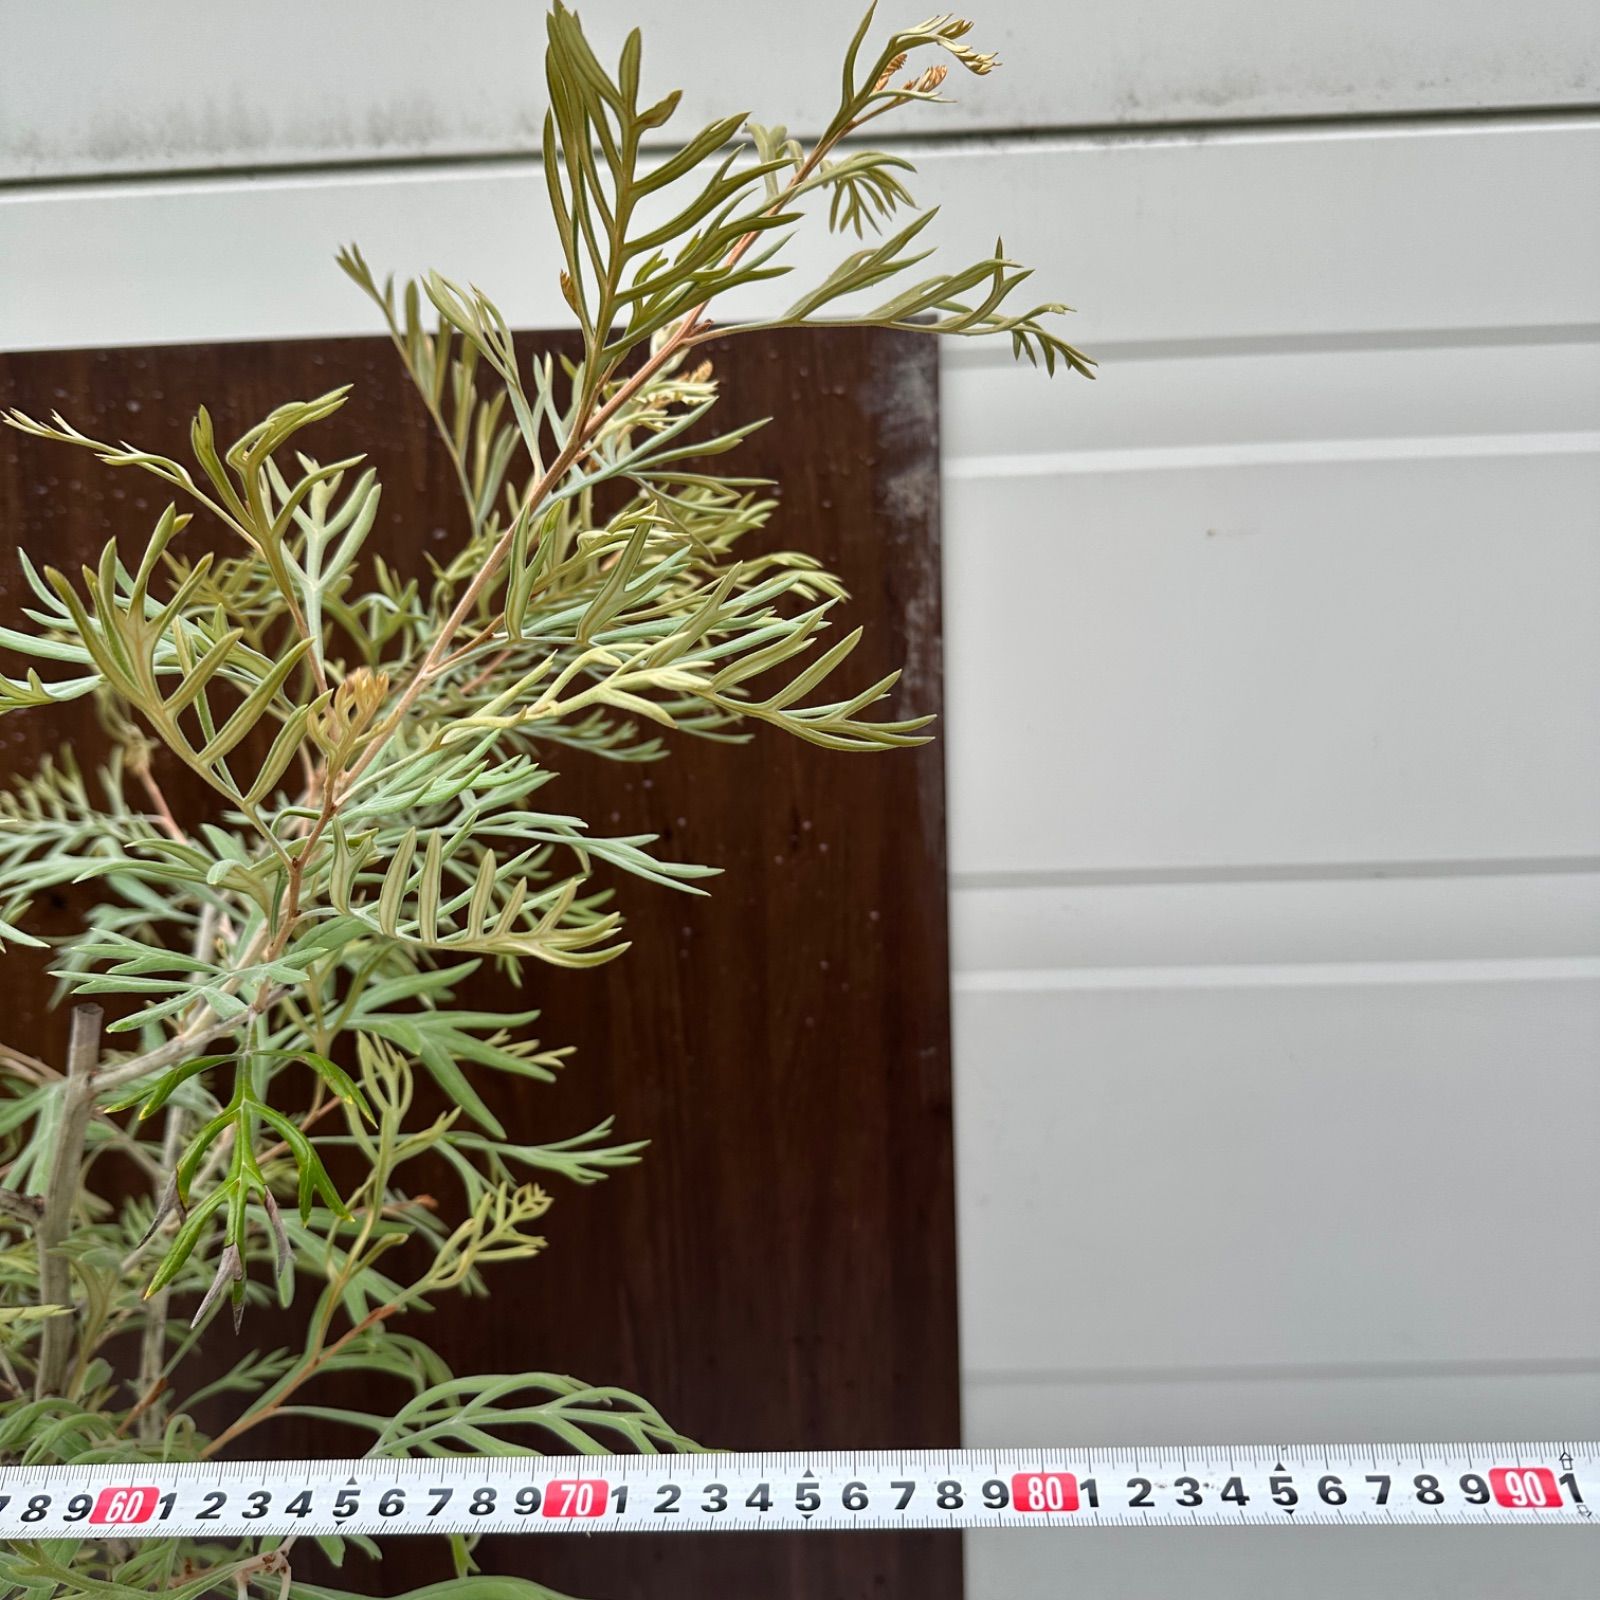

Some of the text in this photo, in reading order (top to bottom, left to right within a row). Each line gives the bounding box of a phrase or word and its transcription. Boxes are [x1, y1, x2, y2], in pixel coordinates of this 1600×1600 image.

[21, 1495, 51, 1522] 8
[63, 1494, 93, 1522] 9
[105, 1490, 145, 1522] 60
[159, 1493, 177, 1520] 1
[195, 1492, 227, 1519] 2
[242, 1491, 271, 1519] 3
[285, 1491, 312, 1518] 4
[333, 1490, 360, 1517] 5
[379, 1489, 405, 1517] 6
[427, 1489, 453, 1516] 7
[469, 1488, 496, 1515] 8
[514, 1487, 541, 1515] 9
[559, 1483, 594, 1516] 70
[611, 1486, 627, 1513] 1
[654, 1485, 681, 1513] 2
[701, 1484, 727, 1512] 3
[746, 1484, 773, 1511] 4
[796, 1483, 820, 1511] 5
[842, 1482, 868, 1510] 6
[891, 1482, 915, 1510] 7
[937, 1481, 963, 1509] 8
[982, 1480, 1009, 1509] 9
[1027, 1476, 1064, 1510] 80
[1080, 1479, 1099, 1507] 1
[1127, 1478, 1155, 1507] 2
[1174, 1477, 1203, 1507] 3
[1221, 1477, 1250, 1506] 4
[1270, 1477, 1298, 1506] 5
[1318, 1476, 1347, 1505] 6
[1366, 1476, 1391, 1505] 7
[1414, 1475, 1444, 1505] 8
[1460, 1474, 1490, 1504] 9
[1504, 1470, 1547, 1506] 90
[1559, 1473, 1583, 1503] 1
